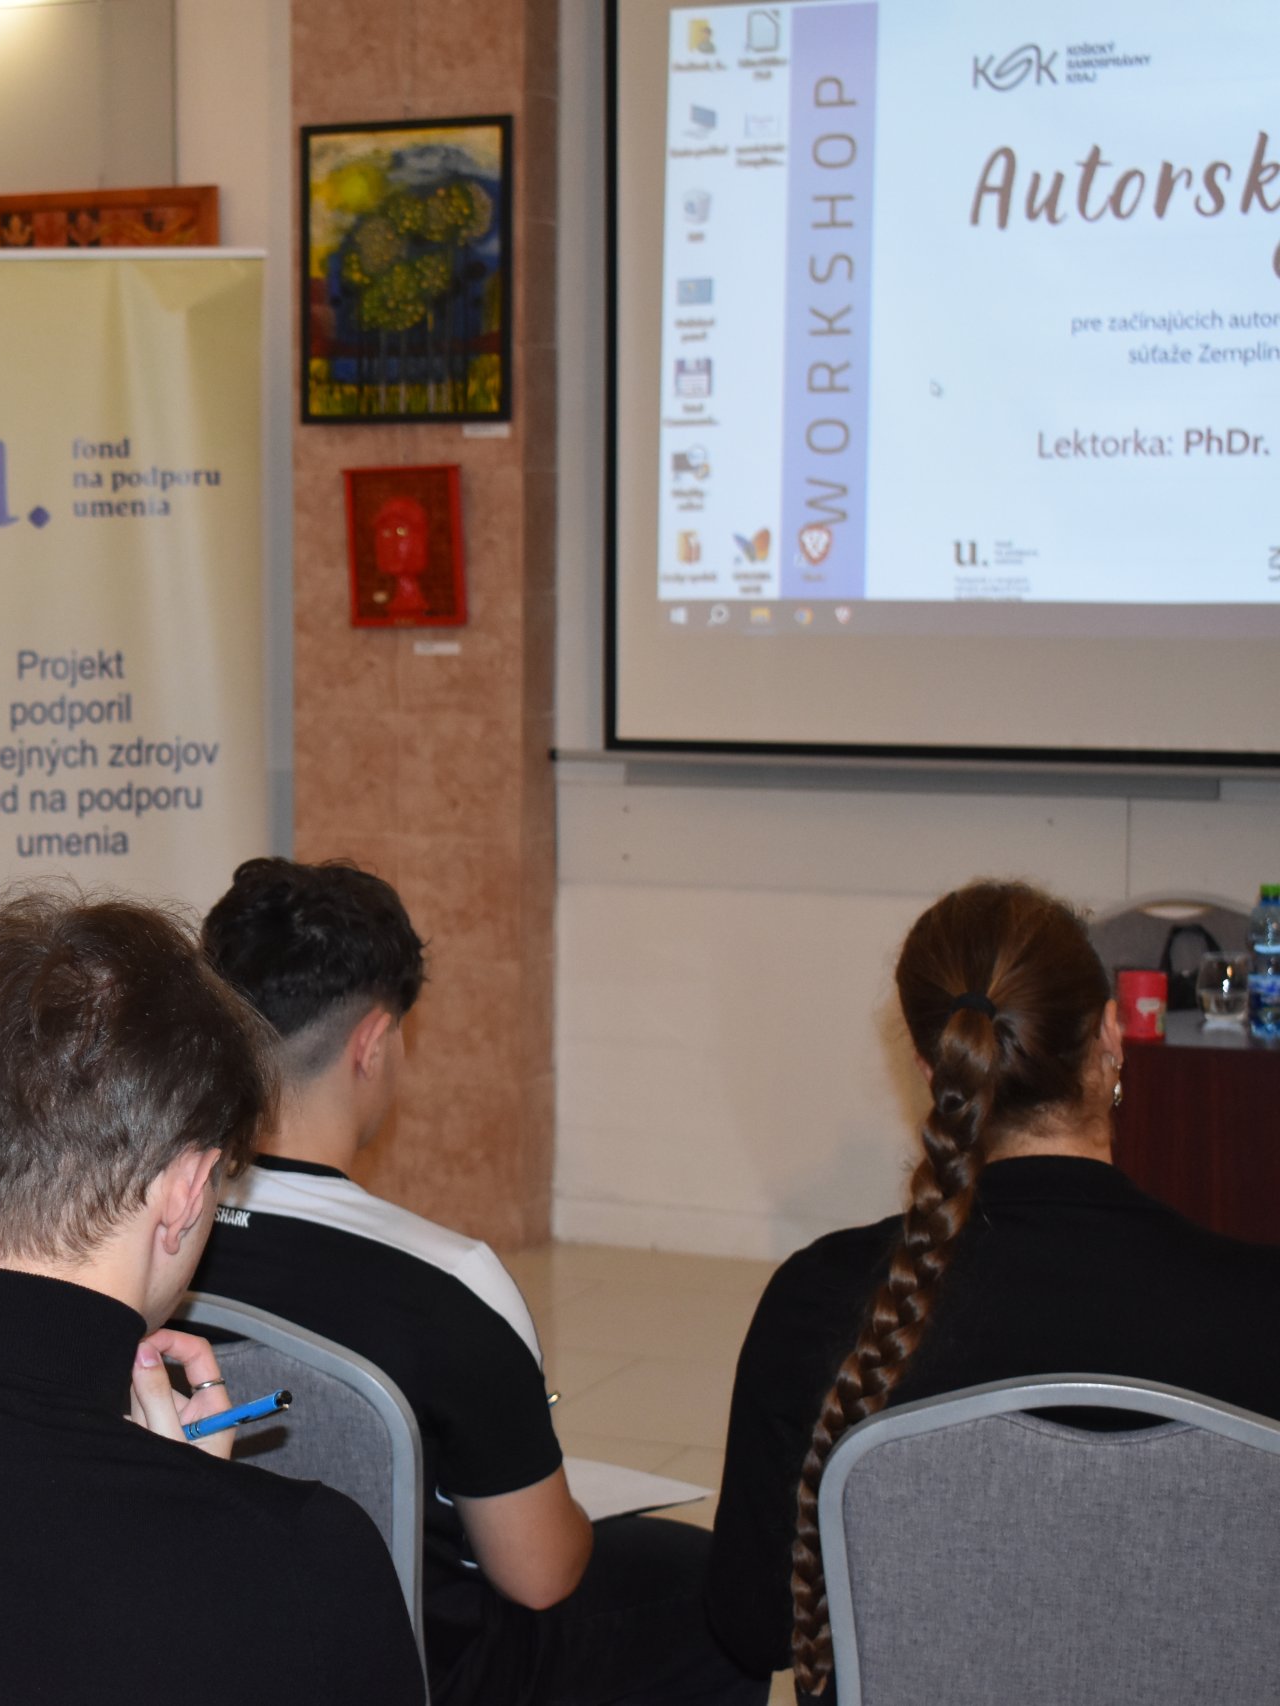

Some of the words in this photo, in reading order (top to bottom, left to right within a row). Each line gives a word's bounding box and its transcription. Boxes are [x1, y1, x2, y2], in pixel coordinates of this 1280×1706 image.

[969, 130, 1280, 231] Autorsk
[805, 75, 857, 525] WORKSHOP
[1070, 317, 1103, 336] pre
[1107, 310, 1224, 334] začínajúcich
[1127, 345, 1194, 364] súťaže
[72, 438, 131, 461] fond
[1036, 426, 1173, 460] Lektorka:
[1183, 424, 1272, 457] PhDr.
[72, 470, 103, 489] na
[111, 466, 222, 492] podporu
[72, 497, 172, 518] umenia
[15, 649, 126, 689] Projekt
[9, 692, 132, 733] podporil
[107, 735, 220, 775] zdrojov
[29, 788, 67, 813] na
[77, 781, 204, 819] podporu
[16, 825, 130, 858] umenia
[216, 1208, 250, 1227] SHARK
